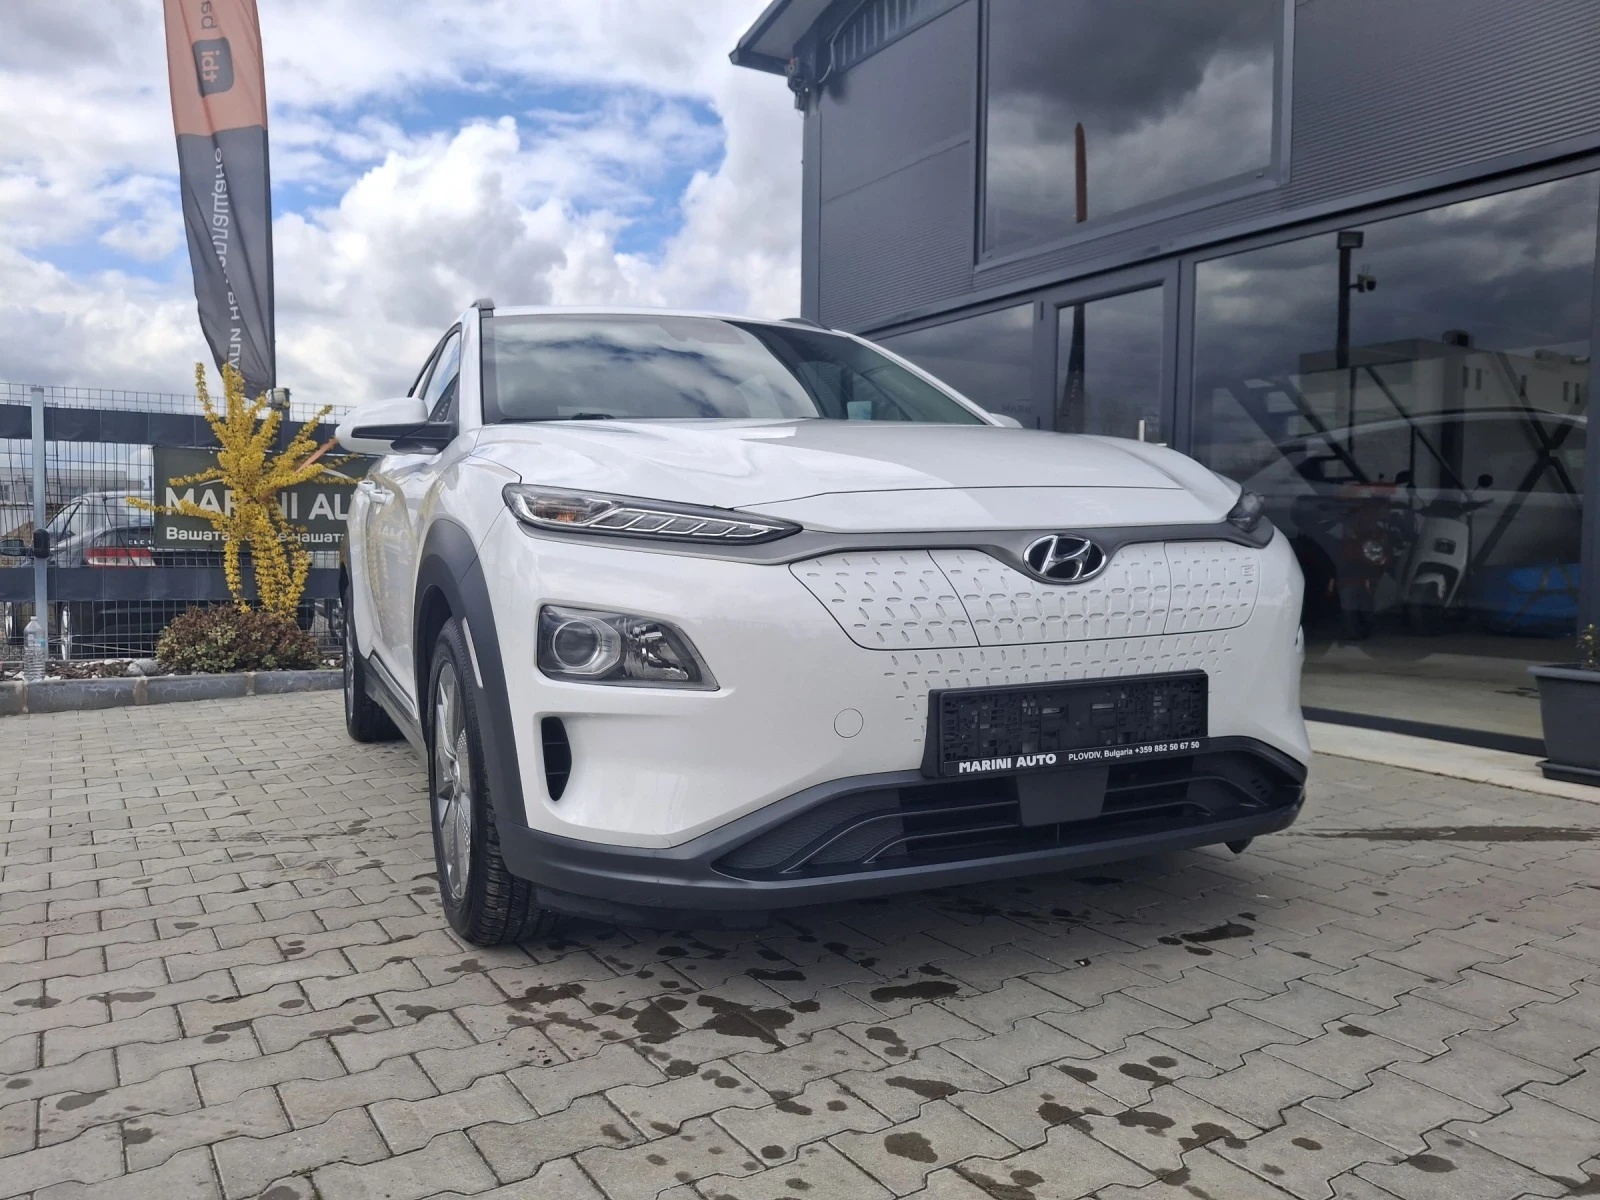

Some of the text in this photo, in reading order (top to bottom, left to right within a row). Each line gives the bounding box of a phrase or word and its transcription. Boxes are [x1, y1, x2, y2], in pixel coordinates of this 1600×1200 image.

[166, 526, 231, 541] Вашата
[959, 757, 1012, 773] MARINI
[1016, 753, 1057, 768] AUTO
[1068, 751, 1103, 761] PLOVDIV,
[1104, 747, 1133, 758] Bulgaria
[1135, 745, 1153, 754] +359
[1154, 743, 1168, 752] 882
[1190, 741, 1200, 749] 50
